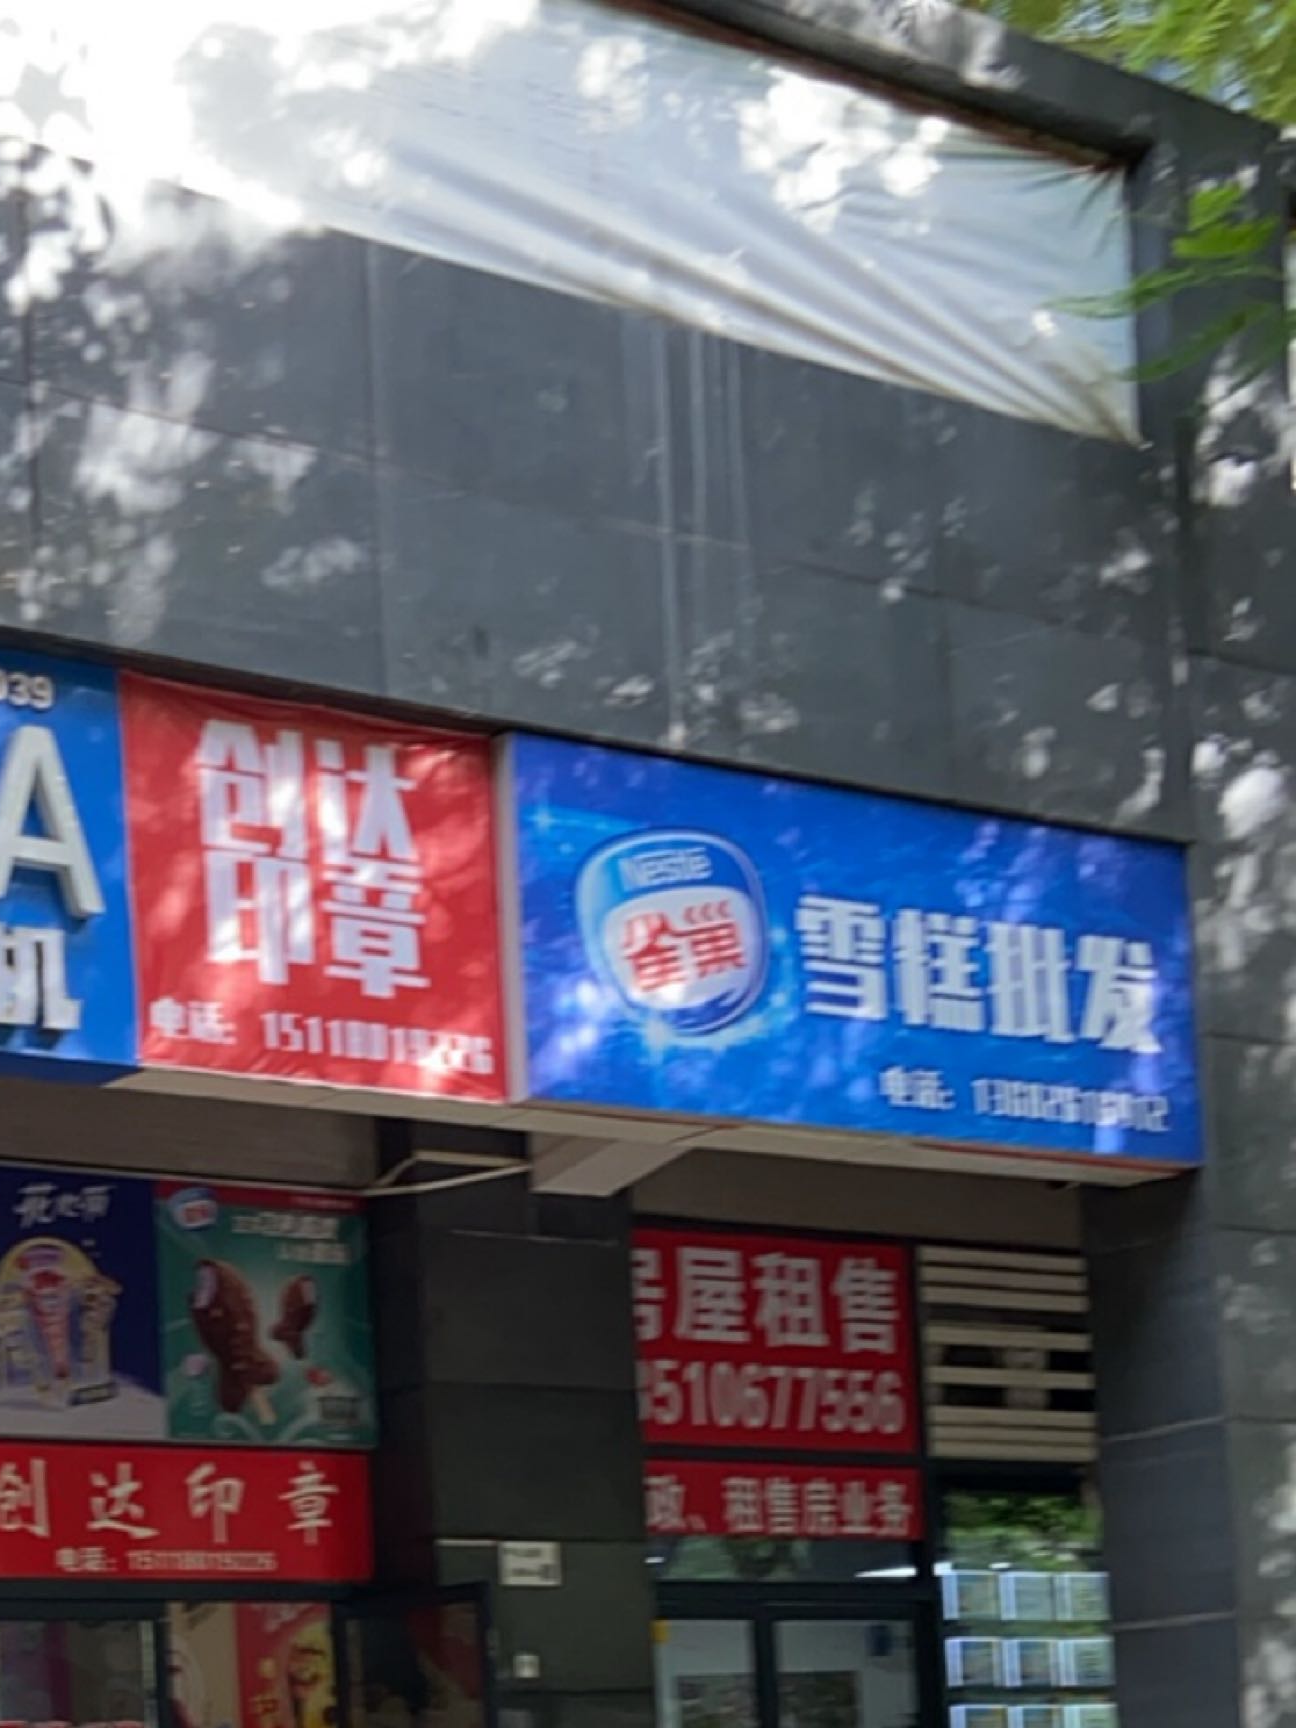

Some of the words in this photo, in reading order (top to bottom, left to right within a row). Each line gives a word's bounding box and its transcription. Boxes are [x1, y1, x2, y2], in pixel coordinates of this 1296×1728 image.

[195, 718, 420, 864] 创达
[206, 850, 431, 1001] 印章
[796, 892, 1163, 1055] 雪糕批发
